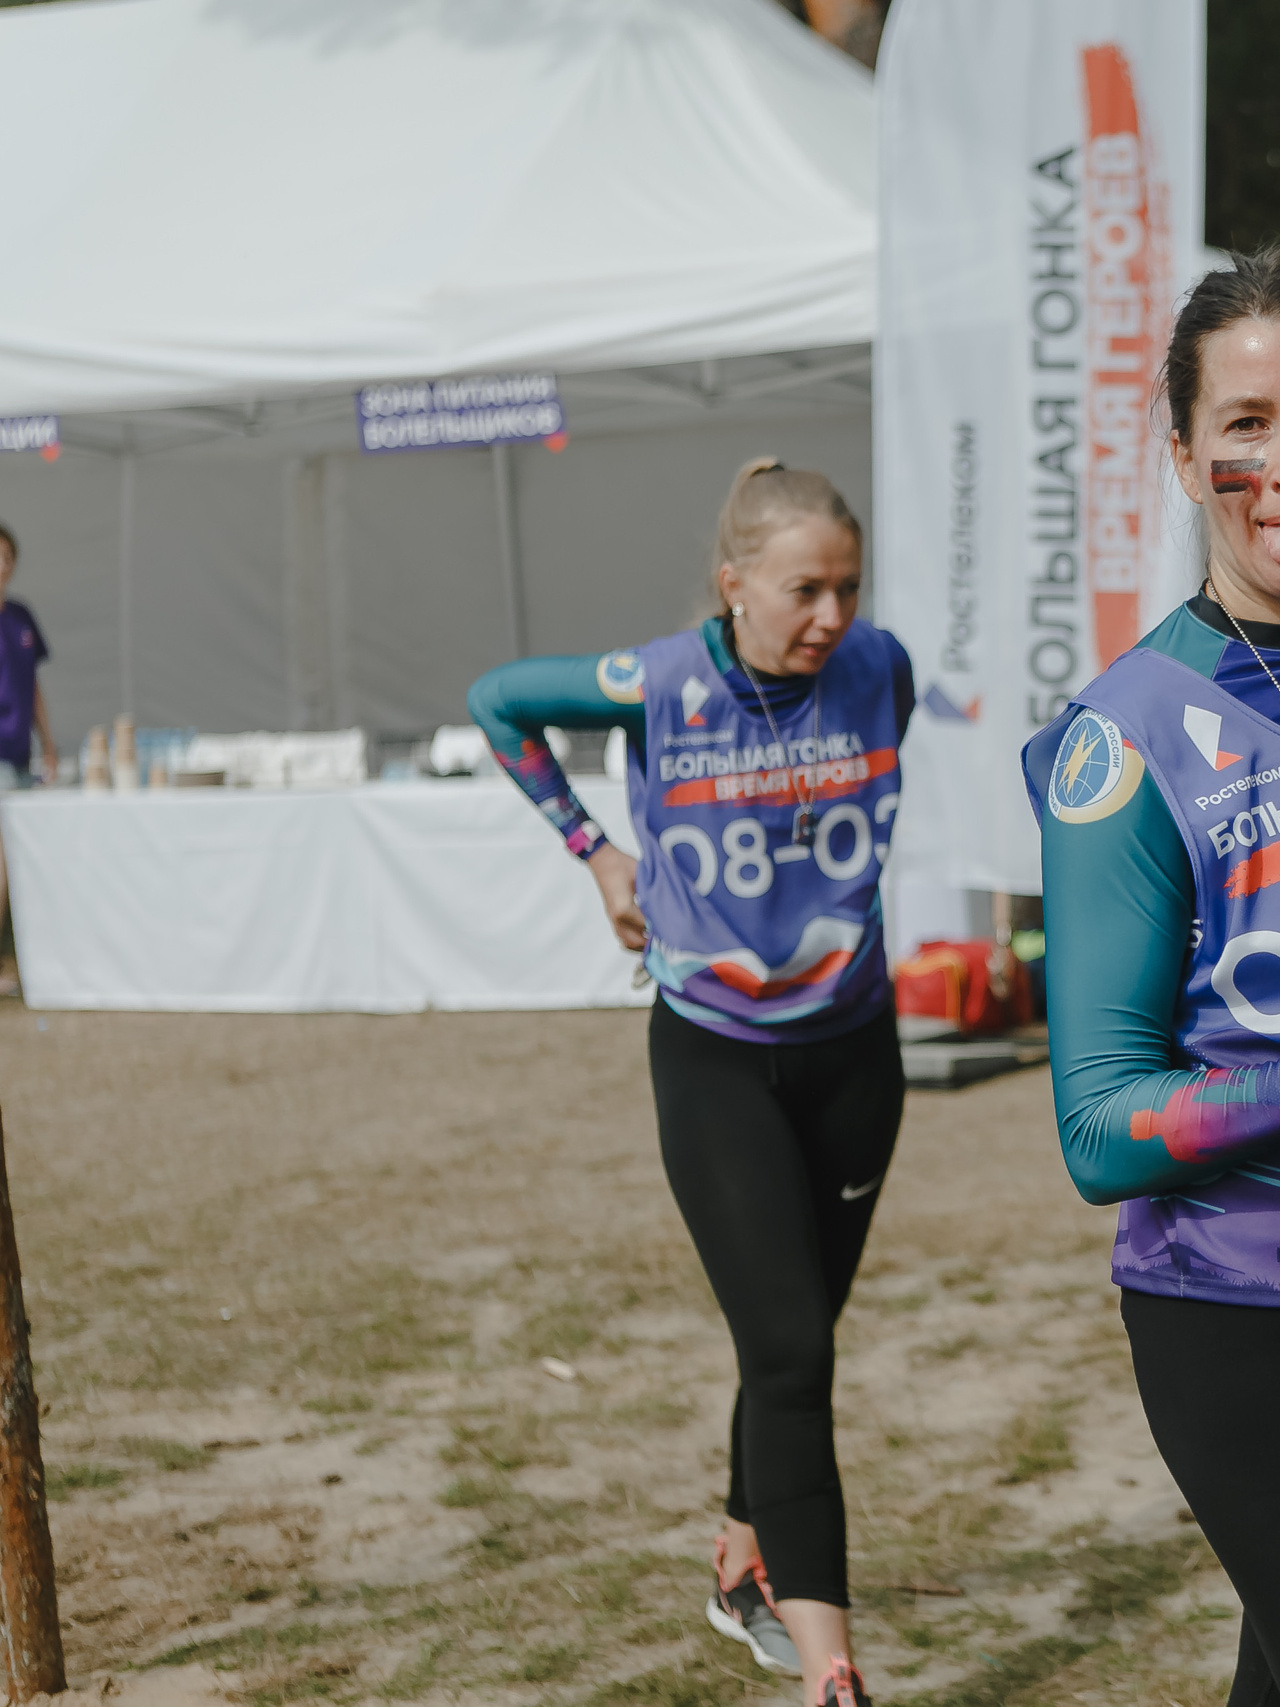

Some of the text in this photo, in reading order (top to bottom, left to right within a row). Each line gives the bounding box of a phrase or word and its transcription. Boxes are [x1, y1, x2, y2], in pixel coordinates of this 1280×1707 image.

[1028, 145, 1081, 373] ГОНКА
[659, 730, 866, 782] БОЛЬШАЯ ГОНКА
[1105, 724, 1121, 769] РОССИИ
[714, 756, 871, 801] ВРЕМЯ ГЕРОЕВ
